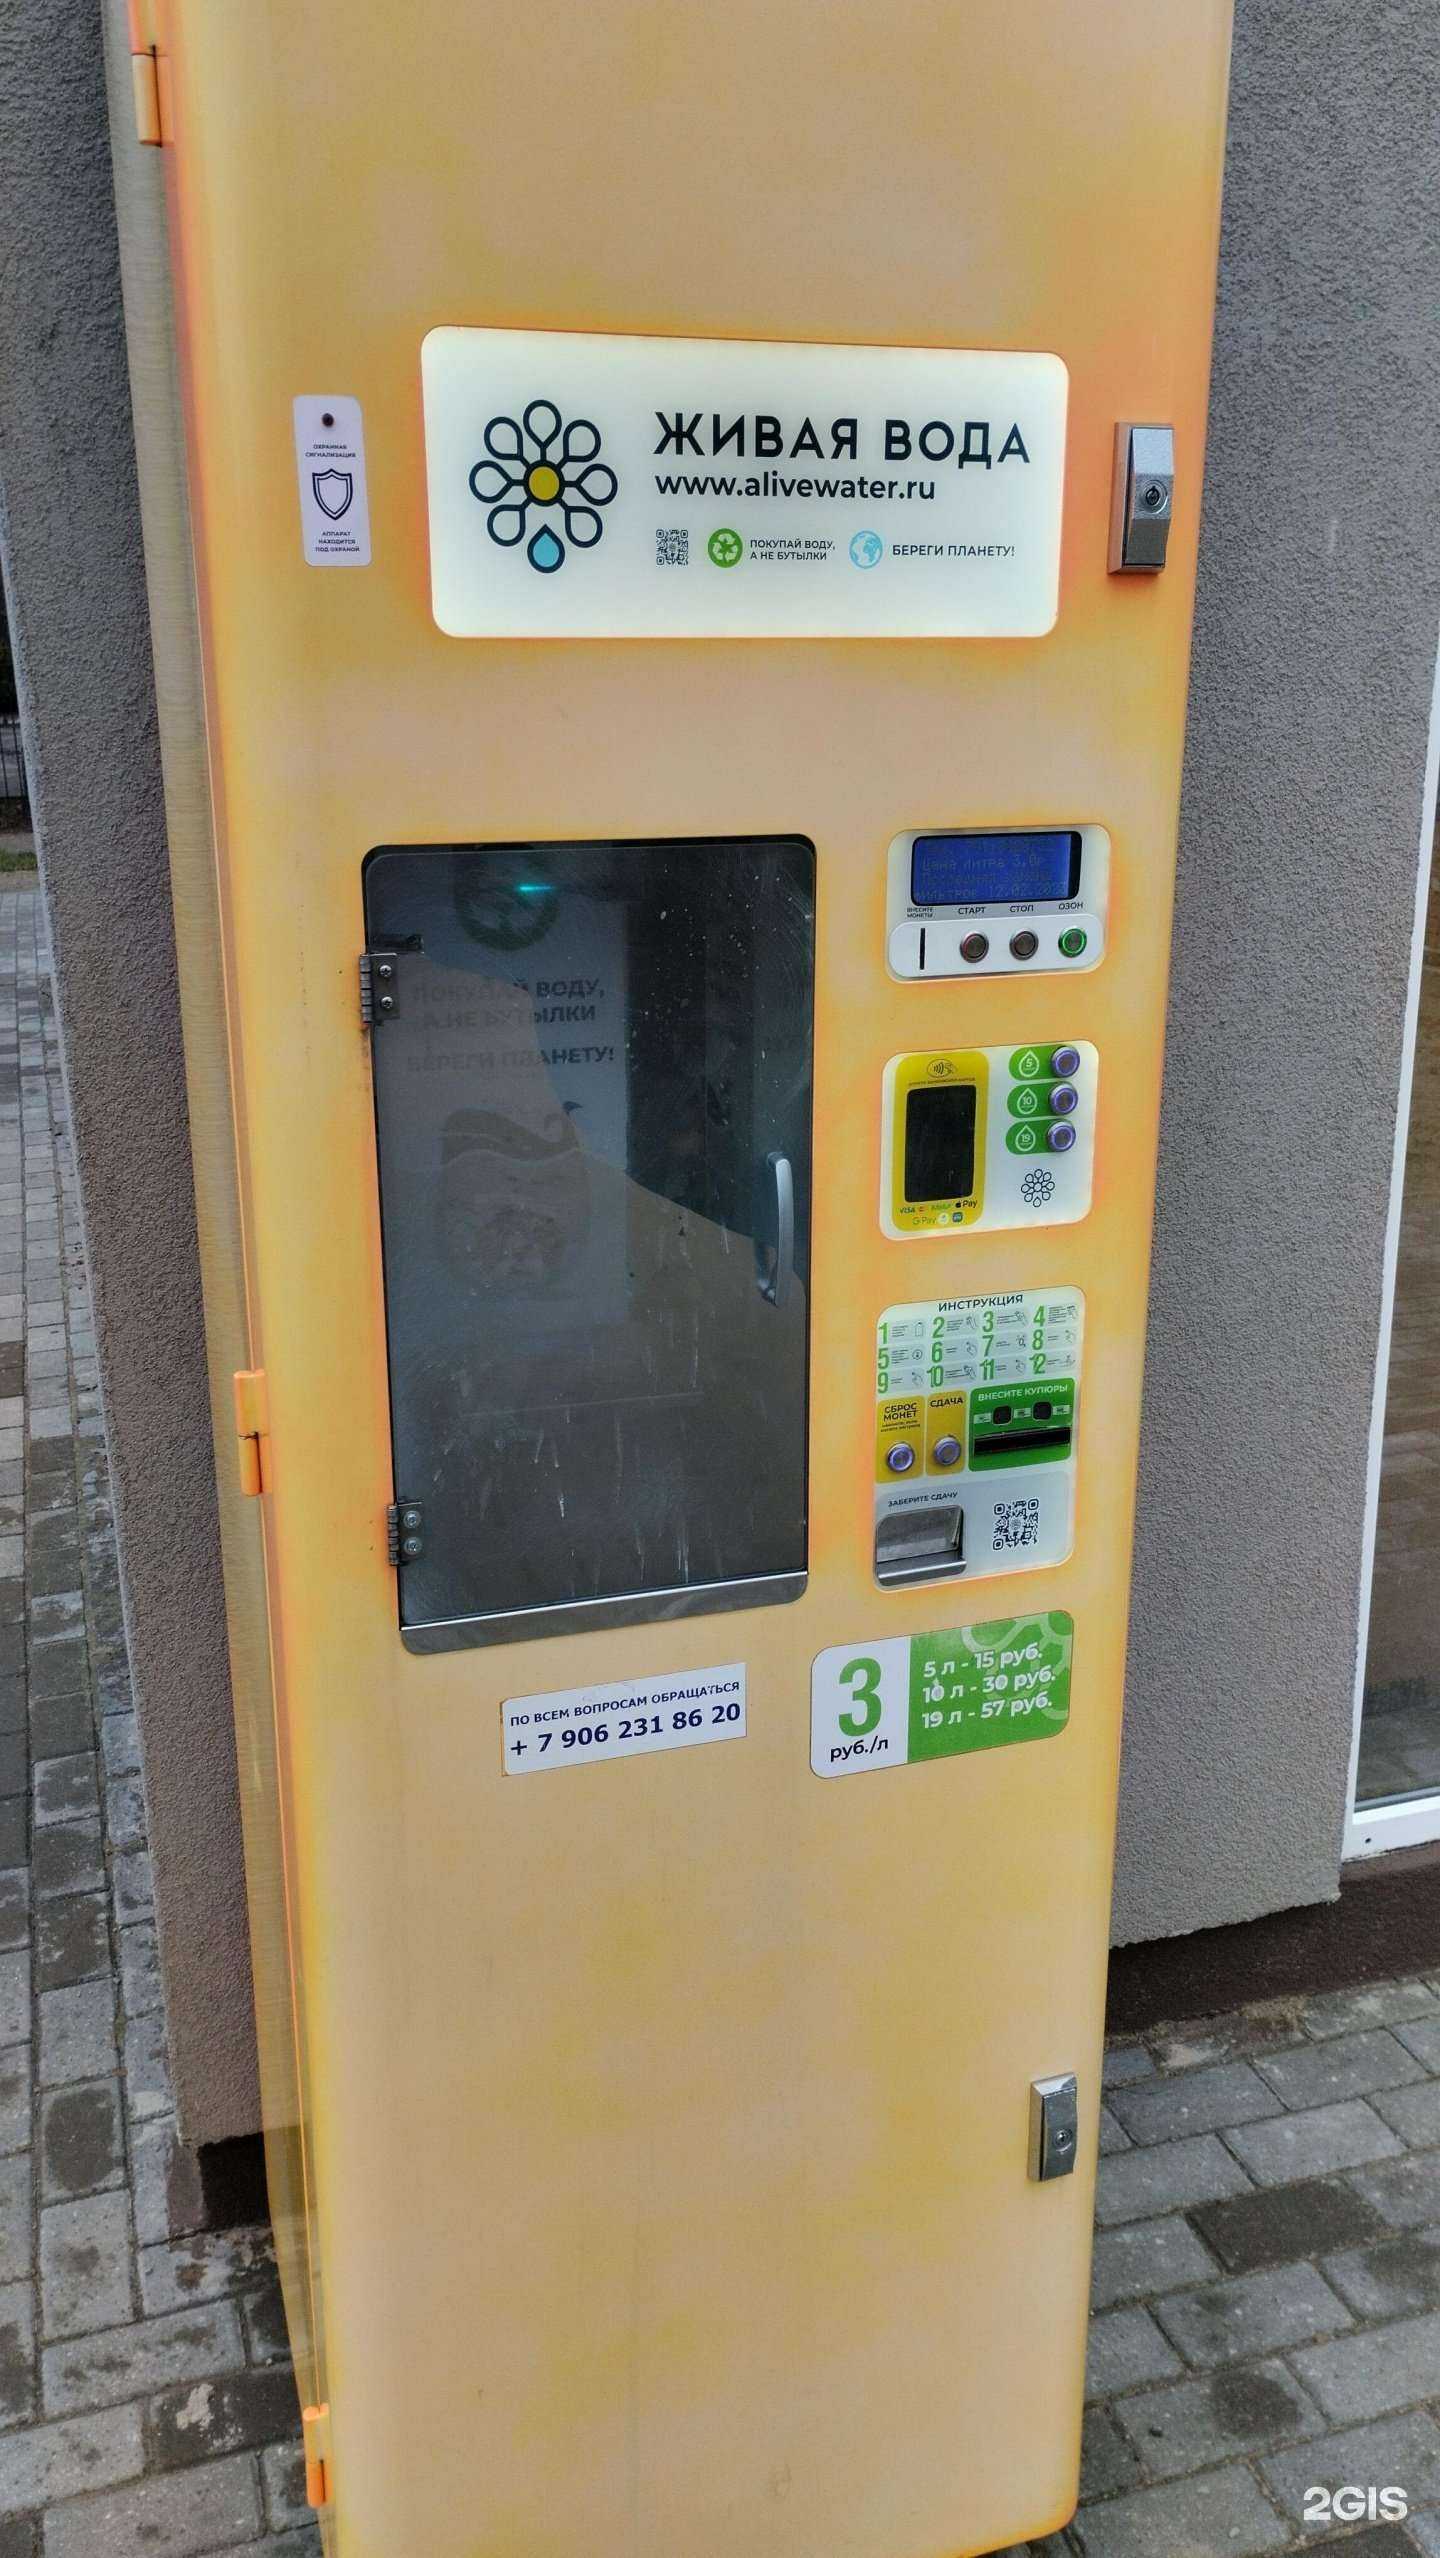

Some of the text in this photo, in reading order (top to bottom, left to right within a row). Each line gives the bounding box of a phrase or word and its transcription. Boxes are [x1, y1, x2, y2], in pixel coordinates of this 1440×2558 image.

[654, 411, 1031, 470] ЖИВАЯ ВОДА
[655, 470, 935, 500] www.alivewater.ru
[750, 538, 836, 550] ПОКУПАЙ ВОДУ,
[892, 543, 1015, 558] БЕРЕГИ ПЛАНЕТУ!
[750, 551, 827, 560] А НЕ БУТЫЛКИ
[958, 906, 986, 915] СТАРТ
[1009, 904, 1034, 913] СТОП
[1058, 901, 1084, 910] ОЗОН
[536, 977, 605, 999] ВОДУ,
[938, 1295, 1023, 1312] ИНСТРУКЦИЯ
[983, 1311, 994, 1332] 3
[1033, 1305, 1045, 1327] 4
[879, 1322, 889, 1344] 1
[932, 1317, 945, 1338] 2
[983, 1335, 994, 1357] 7
[1032, 1329, 1044, 1350] 8
[878, 1348, 889, 1369] 5
[931, 1342, 943, 1363] 6
[979, 1359, 995, 1380] 11
[1029, 1353, 1046, 1375] 12
[878, 1372, 889, 1394] 9
[926, 1365, 943, 1387] 10
[930, 1397, 964, 1409] СДАЧА
[978, 1384, 1068, 1401] ВНЕСИТЕ КУПЮРЫ
[883, 1410, 917, 1422] МОНЕТ
[884, 1402, 917, 1413] СБРОС
[888, 1491, 958, 1507] ЗАБЕРИТЕ СДАЧУ
[923, 1661, 937, 1678] 5
[940, 1659, 955, 1676] л
[974, 1651, 994, 1670] 15
[999, 1642, 1043, 1669] руб.
[922, 1682, 945, 1704] 10
[950, 1683, 964, 1698] л
[982, 1675, 1009, 1693] 30
[1014, 1665, 1056, 1692] руб.
[510, 1681, 740, 1726] ПО ВСЕМ ВОПРОСАМ ОБРАЩАТЬСЯ
[838, 1657, 882, 1737] 3
[922, 1711, 943, 1729] 19
[947, 1709, 962, 1725] л
[980, 1700, 1005, 1719] 57
[1010, 1691, 1053, 1717] руб.
[510, 1702, 741, 1756] + 7 906 231 86 20
[830, 1736, 889, 1762] руб./л
